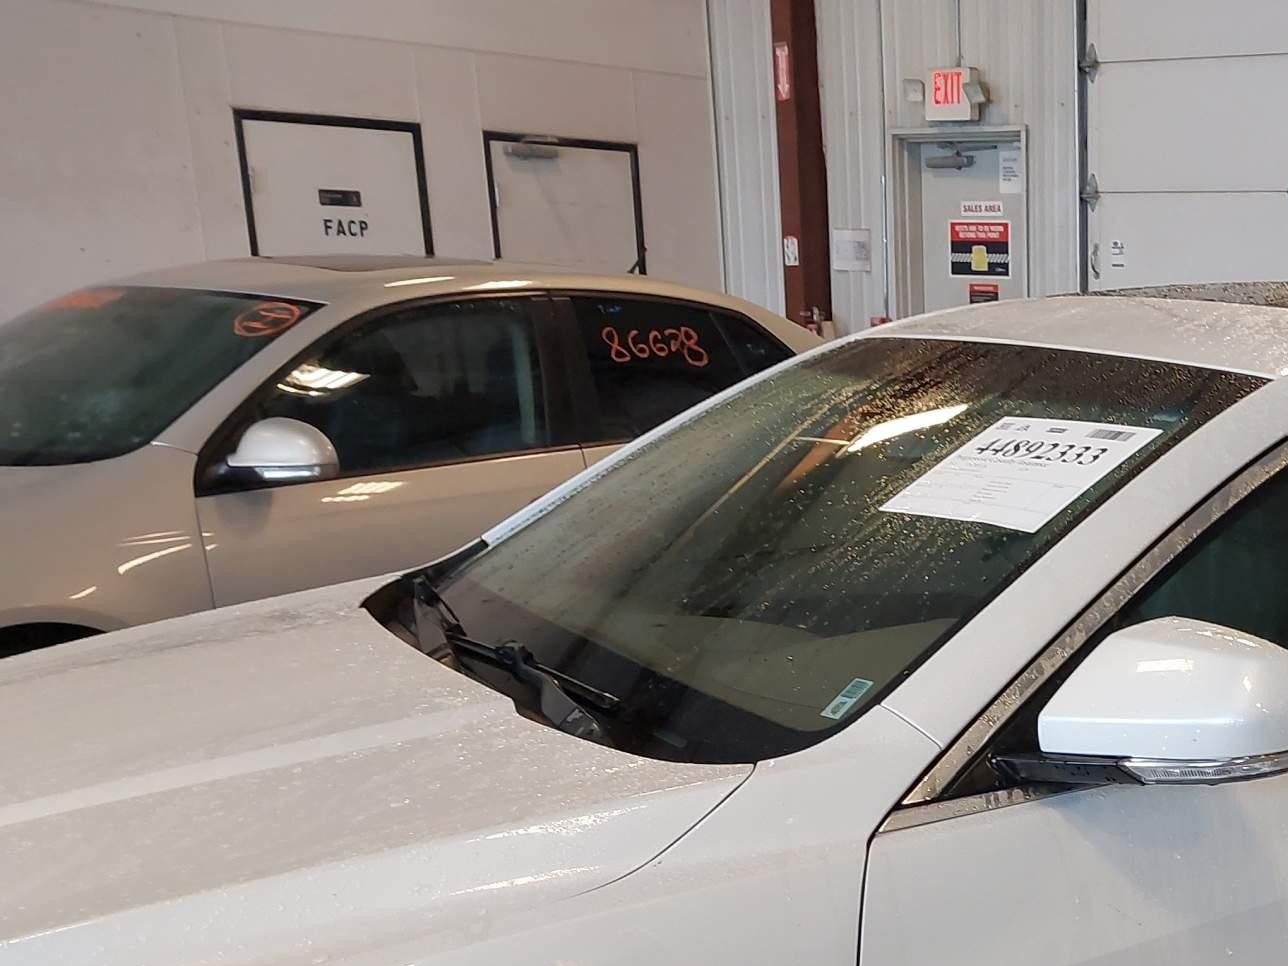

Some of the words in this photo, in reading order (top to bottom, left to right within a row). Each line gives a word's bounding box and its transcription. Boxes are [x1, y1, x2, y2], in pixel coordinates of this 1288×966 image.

[935, 71, 962, 104] EXIT
[963, 204, 982, 213] SALES
[984, 204, 1001, 213] AREA
[323, 218, 369, 237] FACP
[976, 438, 1108, 466] 44892333
